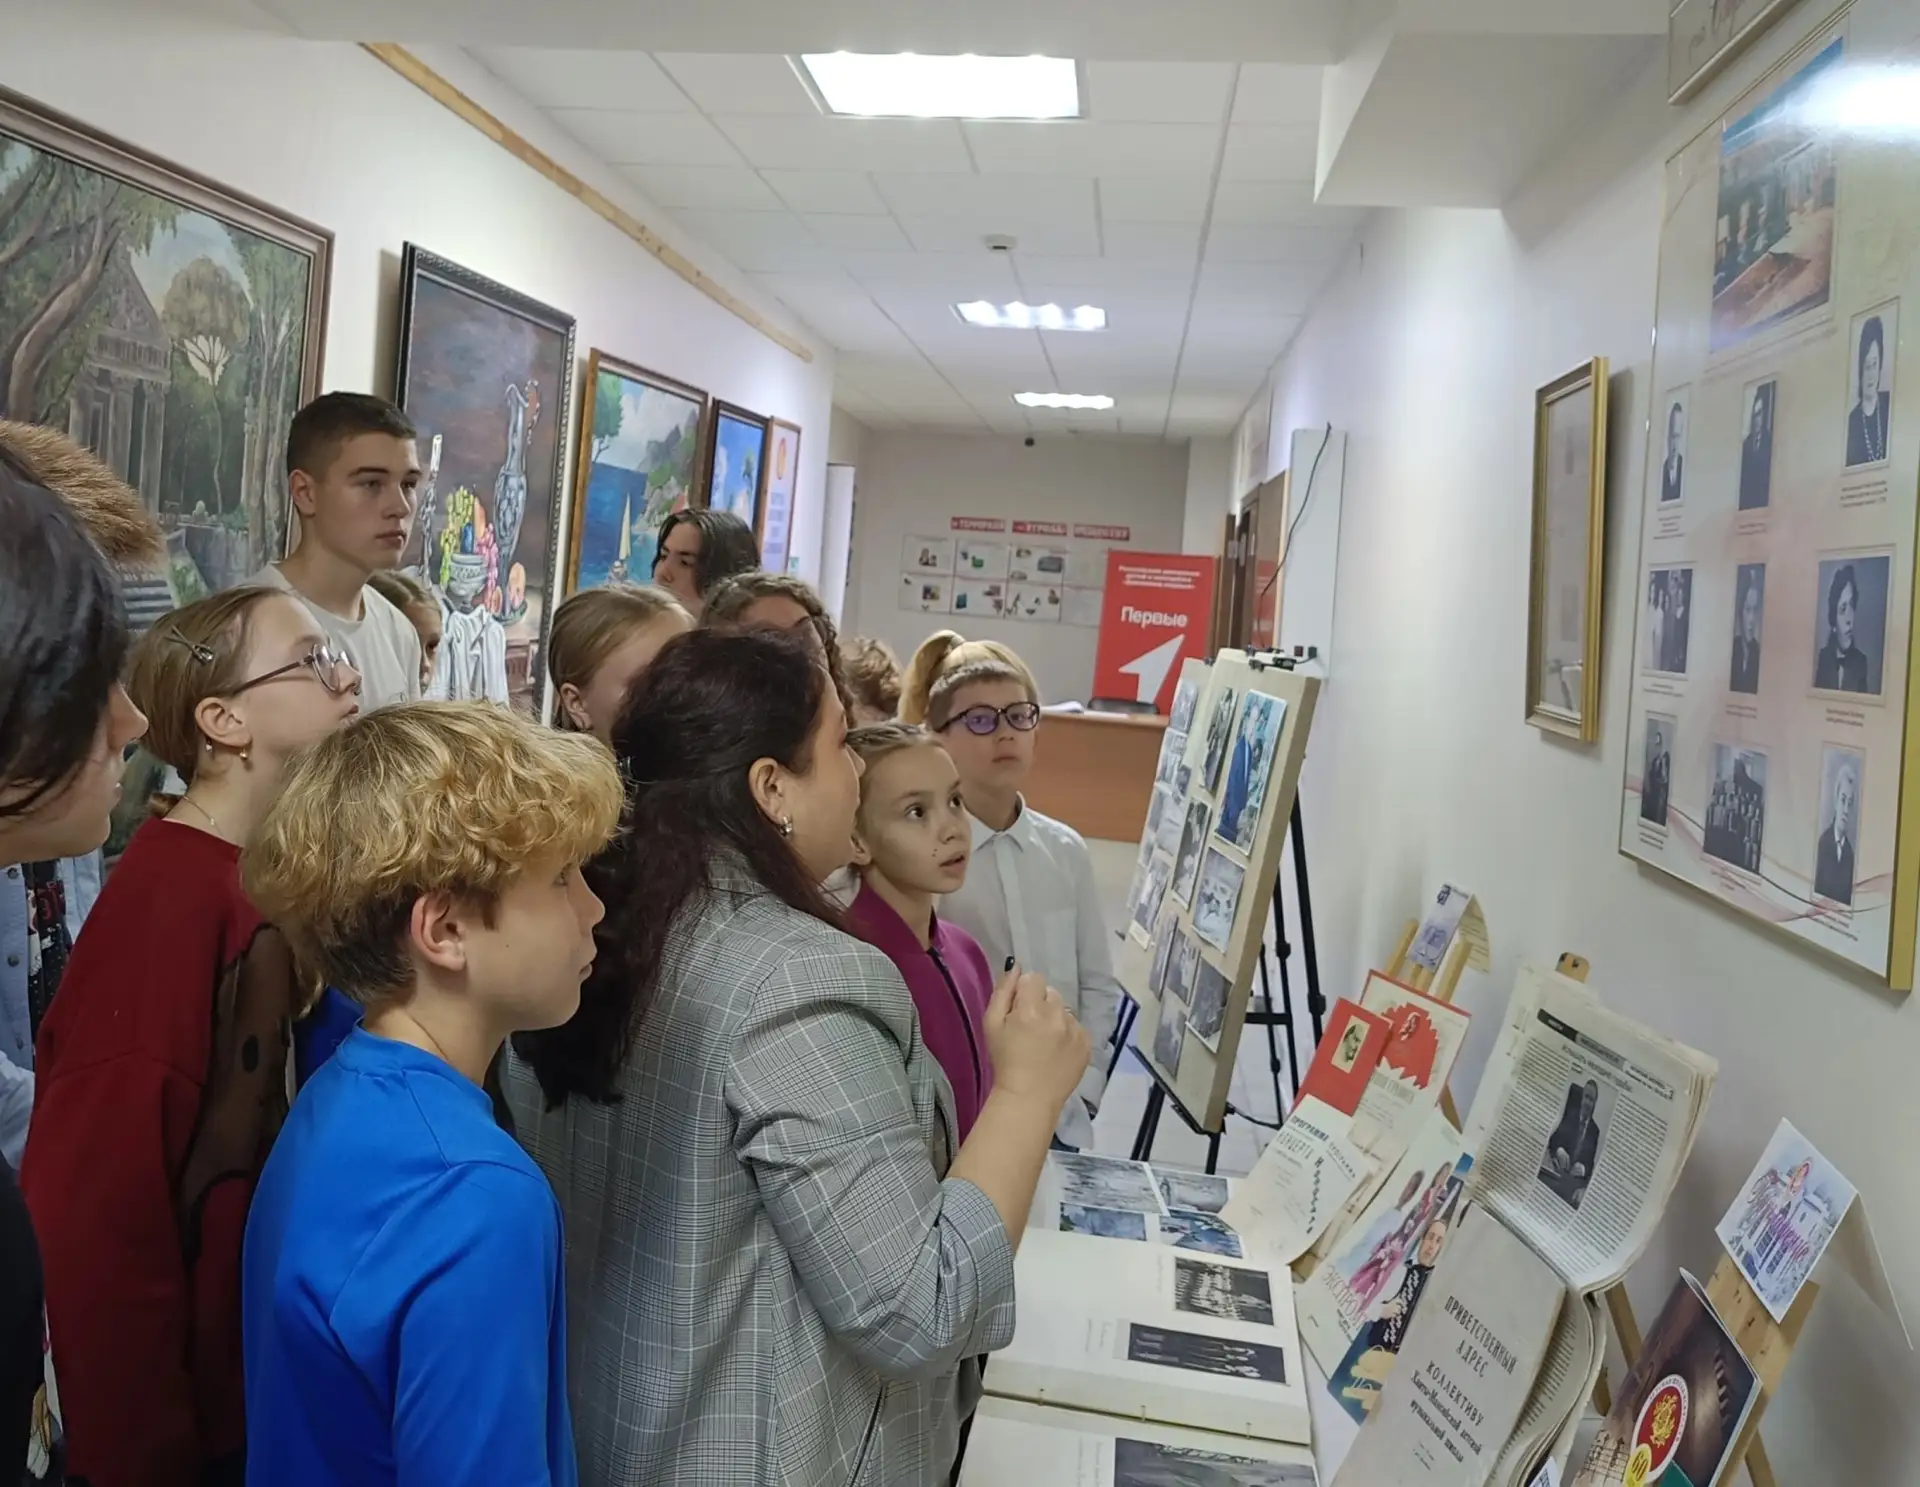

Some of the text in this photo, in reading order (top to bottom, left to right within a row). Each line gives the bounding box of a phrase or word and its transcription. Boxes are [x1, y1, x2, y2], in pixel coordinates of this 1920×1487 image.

[1121, 606, 1188, 629] Первые
[1444, 1295, 1518, 1376] ПРИВЕТСТВЕННЫЙ
[1455, 1339, 1489, 1378] АДРЕС
[1425, 1360, 1485, 1427] КОЛЛЕКТИВУ
[1631, 1450, 1649, 1482] 60
